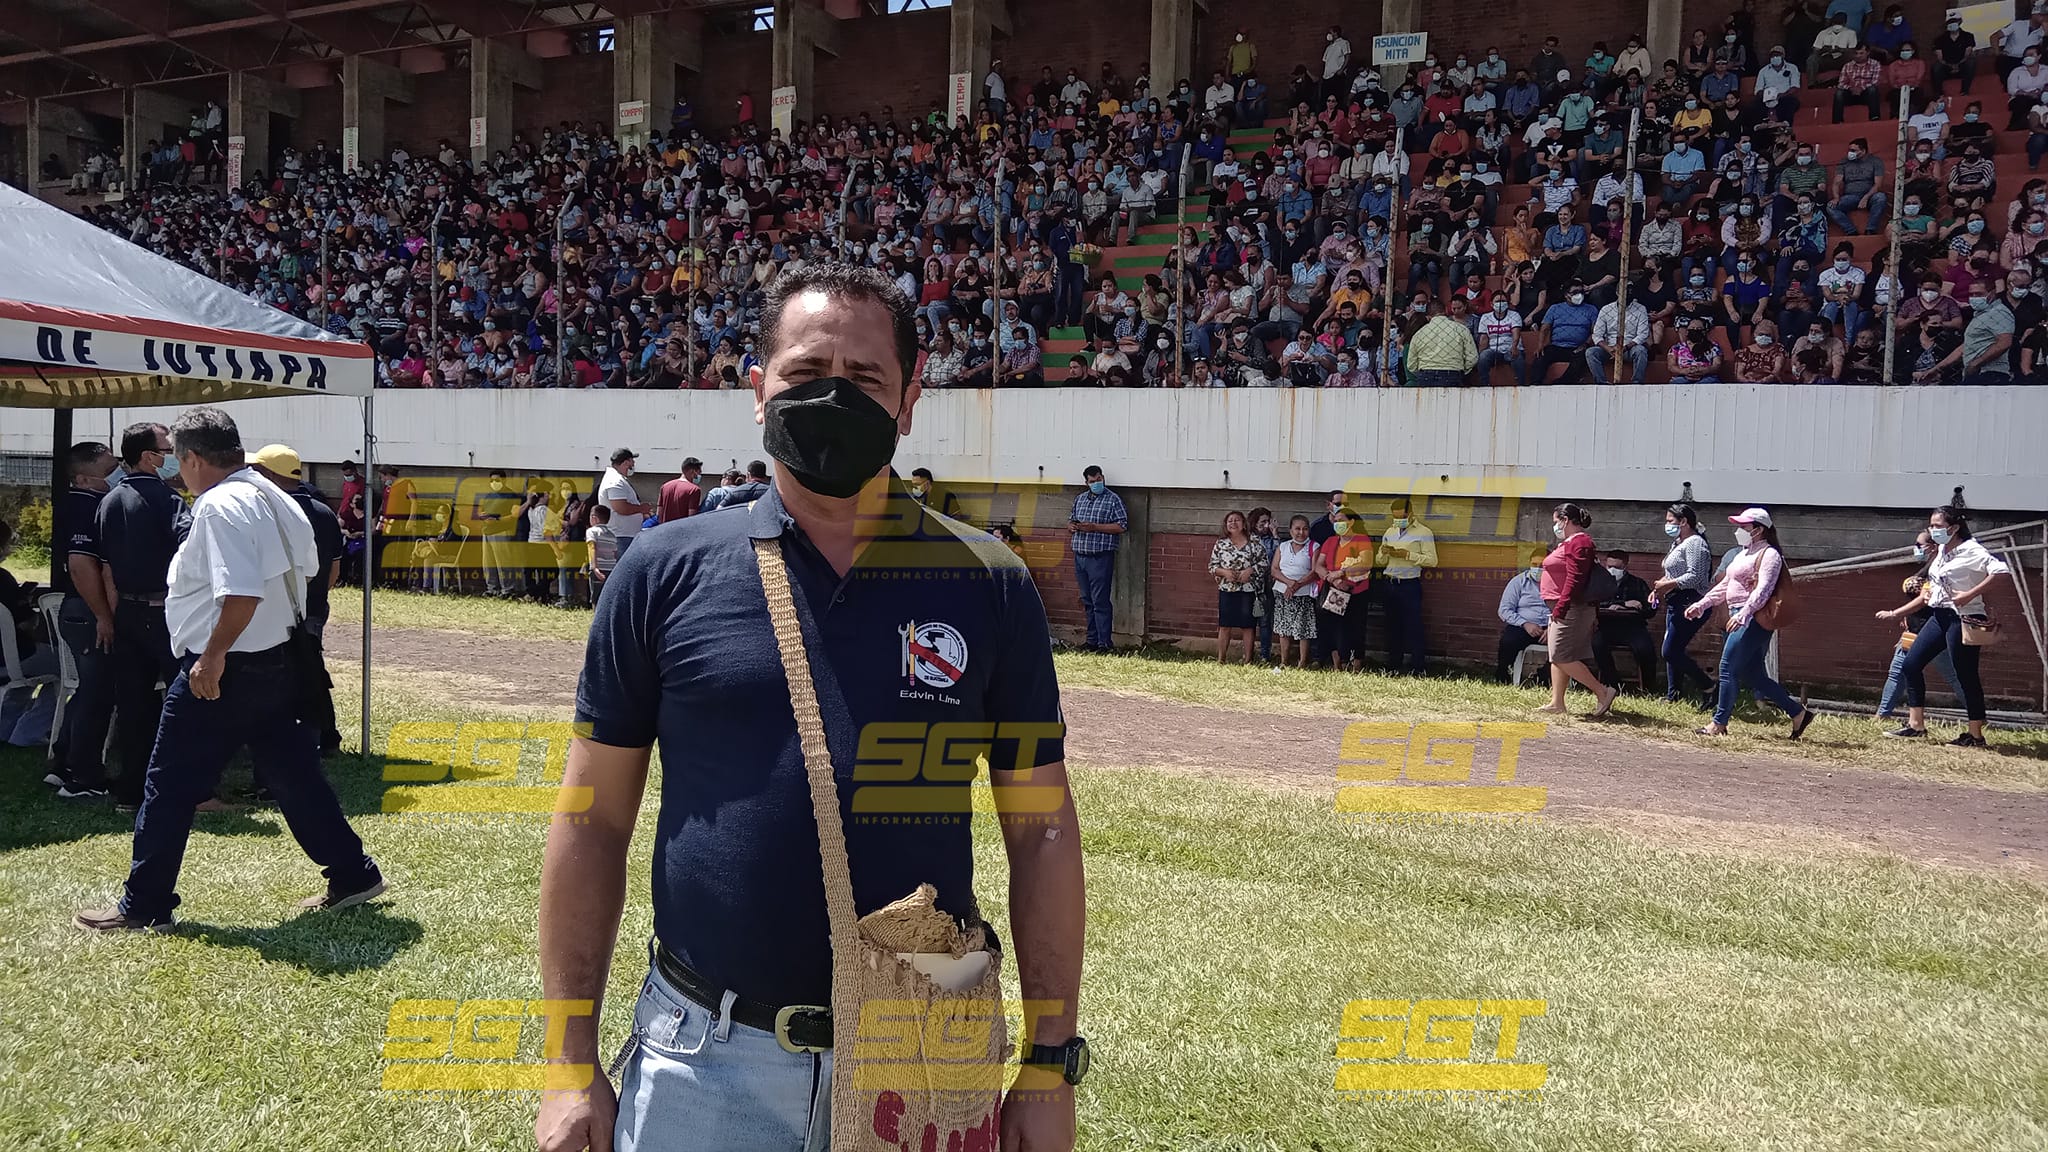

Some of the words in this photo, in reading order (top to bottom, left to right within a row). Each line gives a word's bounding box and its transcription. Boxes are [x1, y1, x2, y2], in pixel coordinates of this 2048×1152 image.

[1374, 35, 1421, 49] ASUNCION
[1385, 48, 1409, 60] MITA
[36, 326, 99, 365] DE
[143, 339, 328, 390] JUTIAPA
[900, 690, 935, 701] Edvin
[939, 693, 961, 705] Lima
